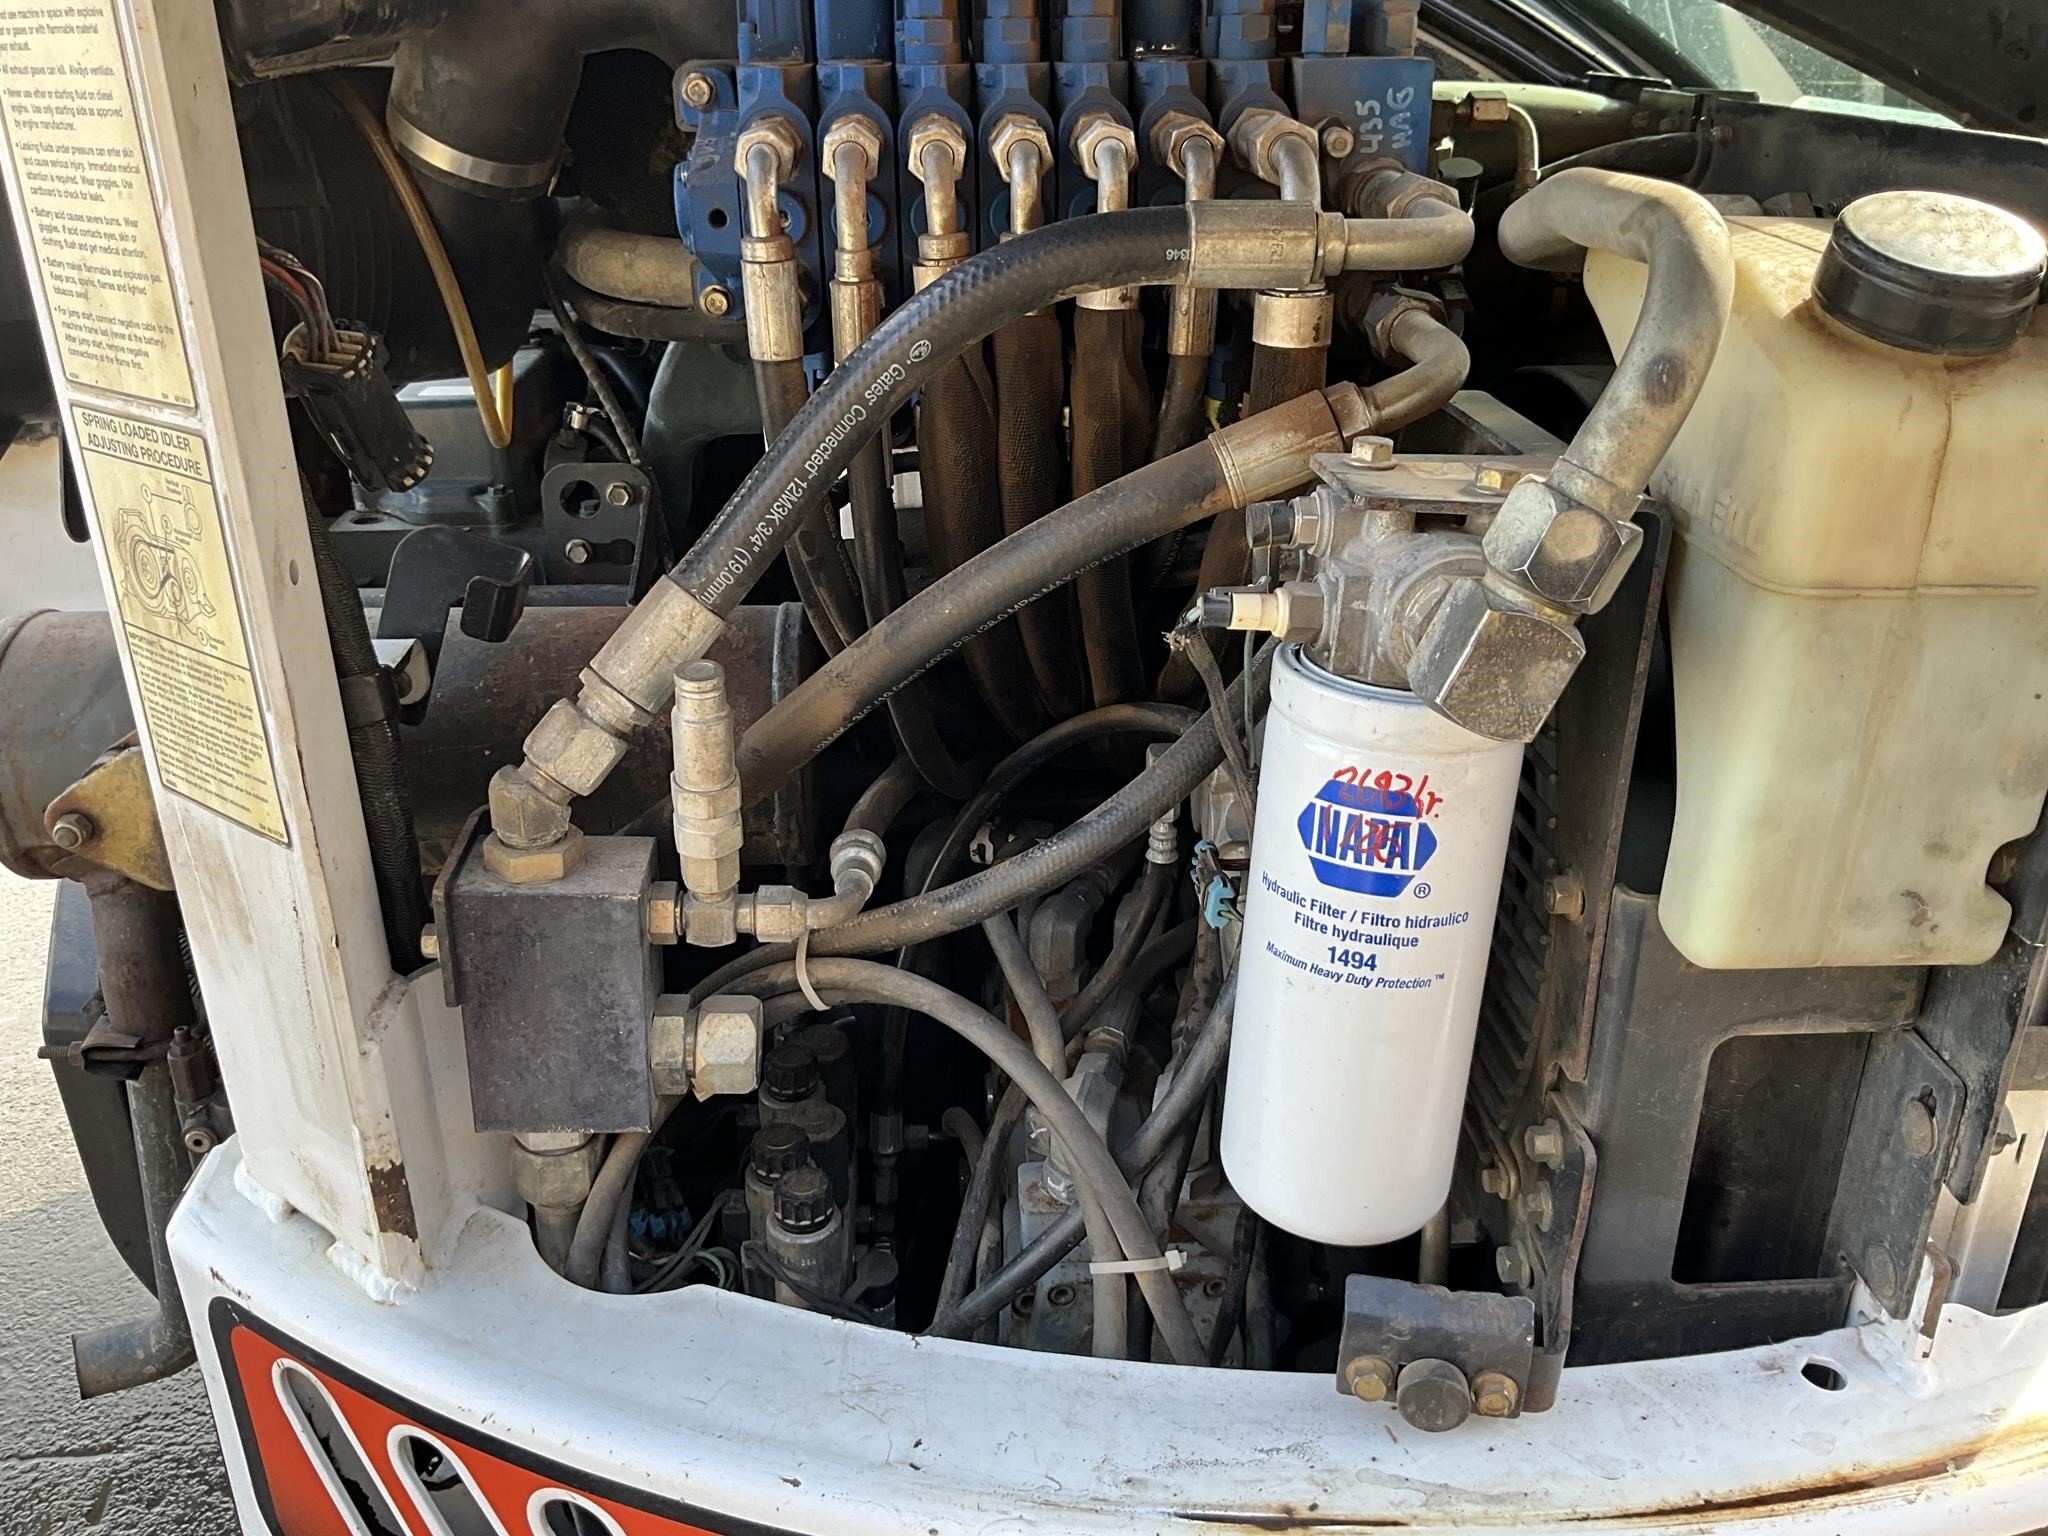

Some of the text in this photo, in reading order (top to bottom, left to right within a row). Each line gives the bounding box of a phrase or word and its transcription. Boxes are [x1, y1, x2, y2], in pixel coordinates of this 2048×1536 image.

[1354, 99, 1383, 153] 435
[81, 411, 192, 453] SPRING LOADED IDLER
[87, 432, 203, 476] ADJUSTING PROCEDURE
[765, 477, 808, 526] 12M3K
[749, 521, 773, 553] 3/4"
[1316, 805, 1411, 870] NAPA
[1262, 871, 1469, 930] Hydraulic Filter / Filtro hidraulico
[1294, 911, 1420, 950] Filtre hydraulique
[1265, 941, 1431, 989] Maximum Heavy Duty Protection
[1327, 946, 1377, 972] 1494
